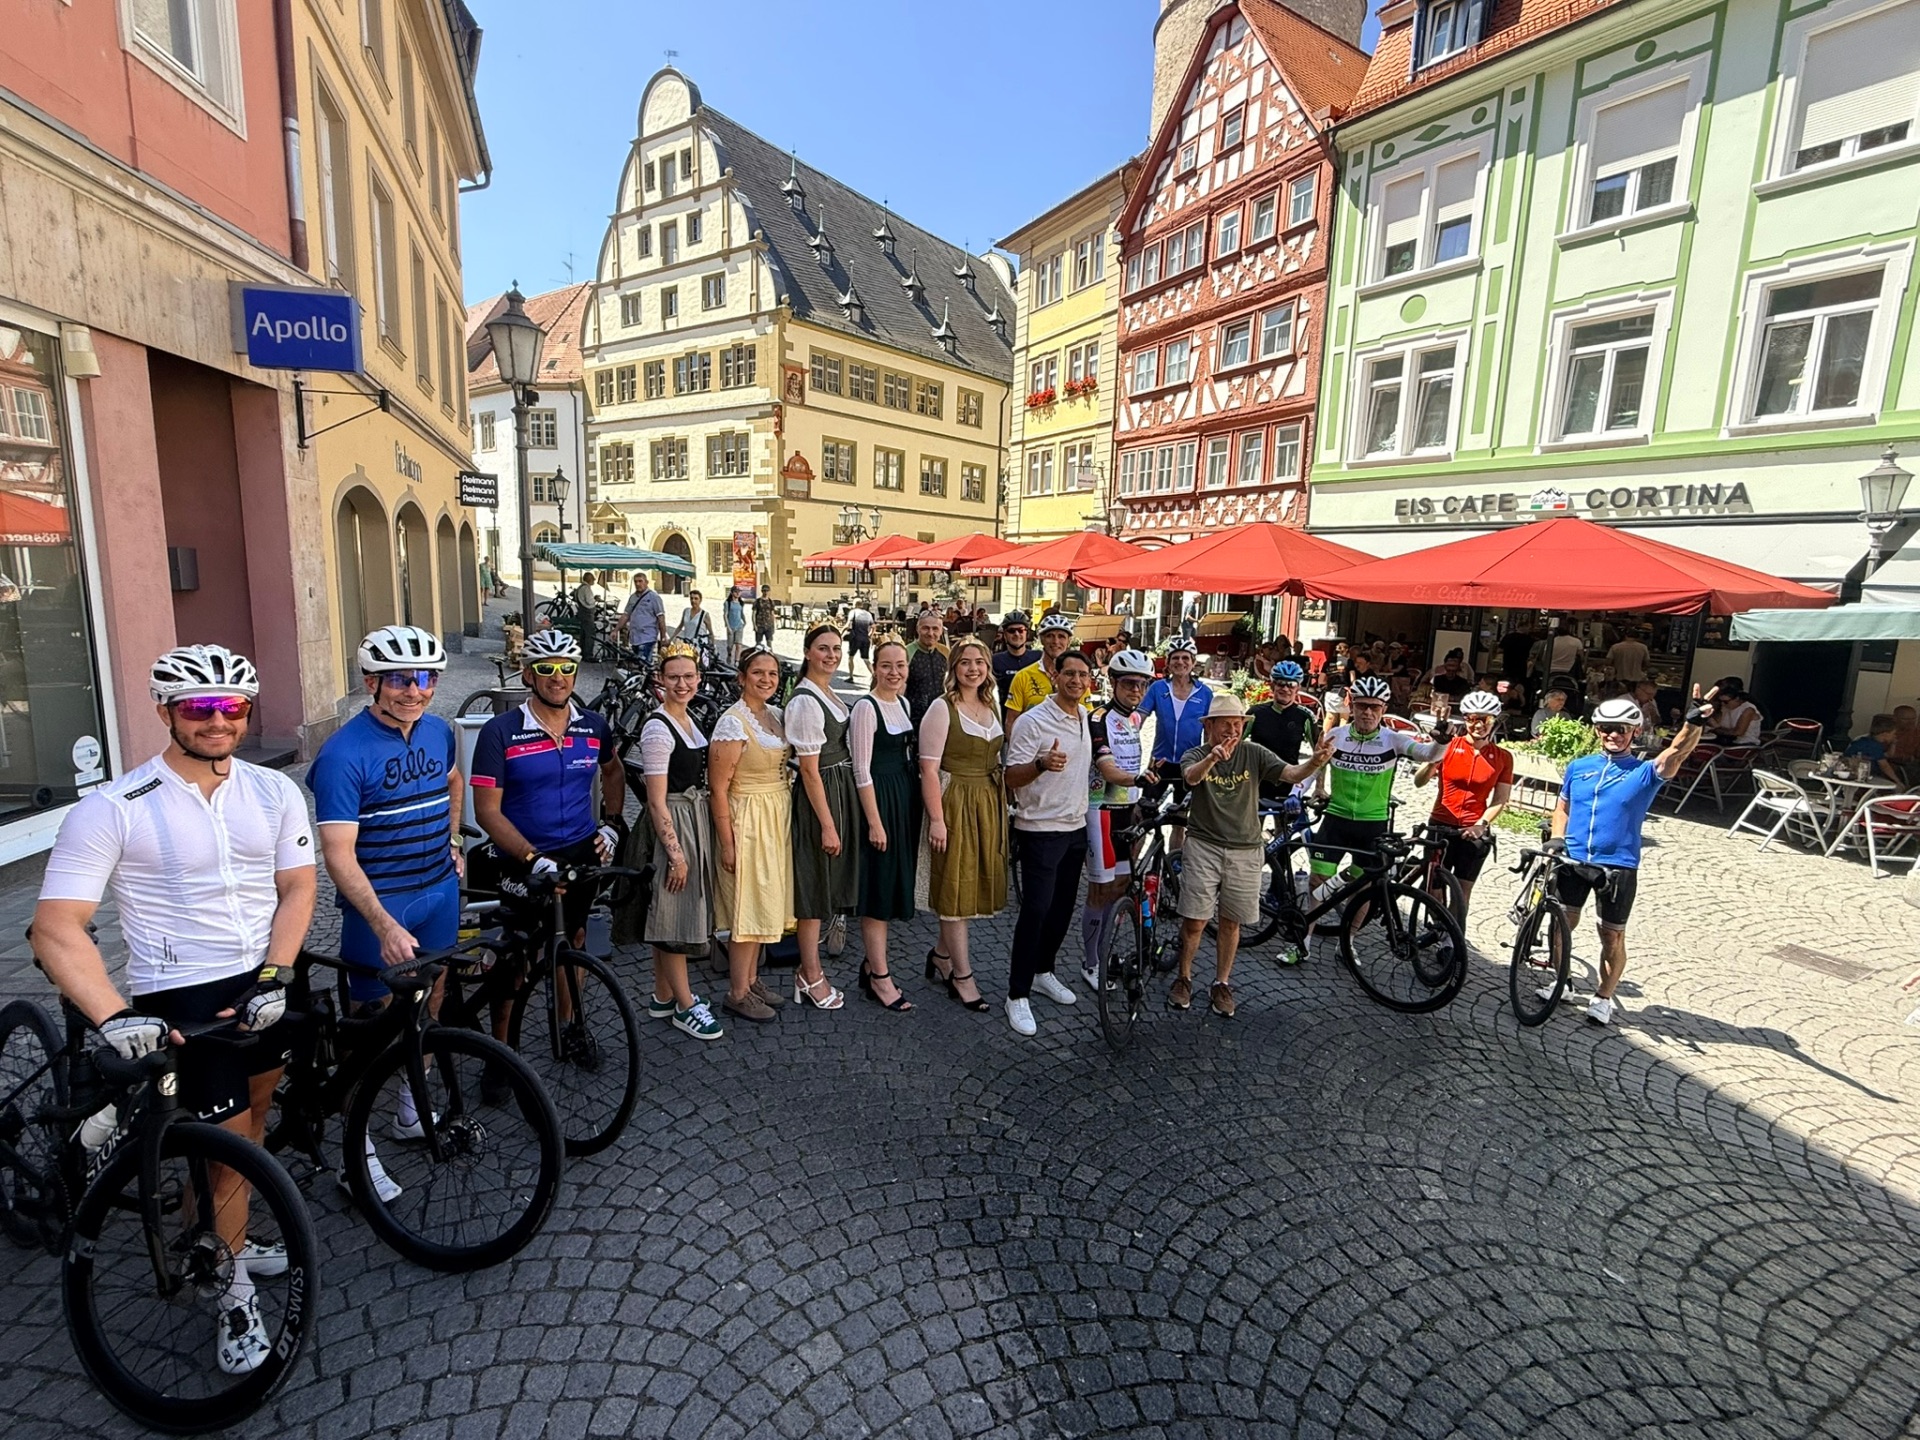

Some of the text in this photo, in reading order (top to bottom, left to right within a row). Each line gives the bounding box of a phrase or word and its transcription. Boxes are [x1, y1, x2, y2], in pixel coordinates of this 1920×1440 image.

[252, 312, 348, 344] Apollo
[1394, 482, 1750, 516] EIS CAFE CORTINA
[1009, 565, 1033, 576] Rösner
[1411, 584, 1432, 599] Eis
[1476, 586, 1537, 602] Cortina
[1335, 760, 1385, 773] CIMA COPPI
[1341, 753, 1381, 764] STELVIO
[1205, 769, 1250, 790] magine
[276, 1324, 294, 1360] DT
[287, 1266, 304, 1325] SWISS
